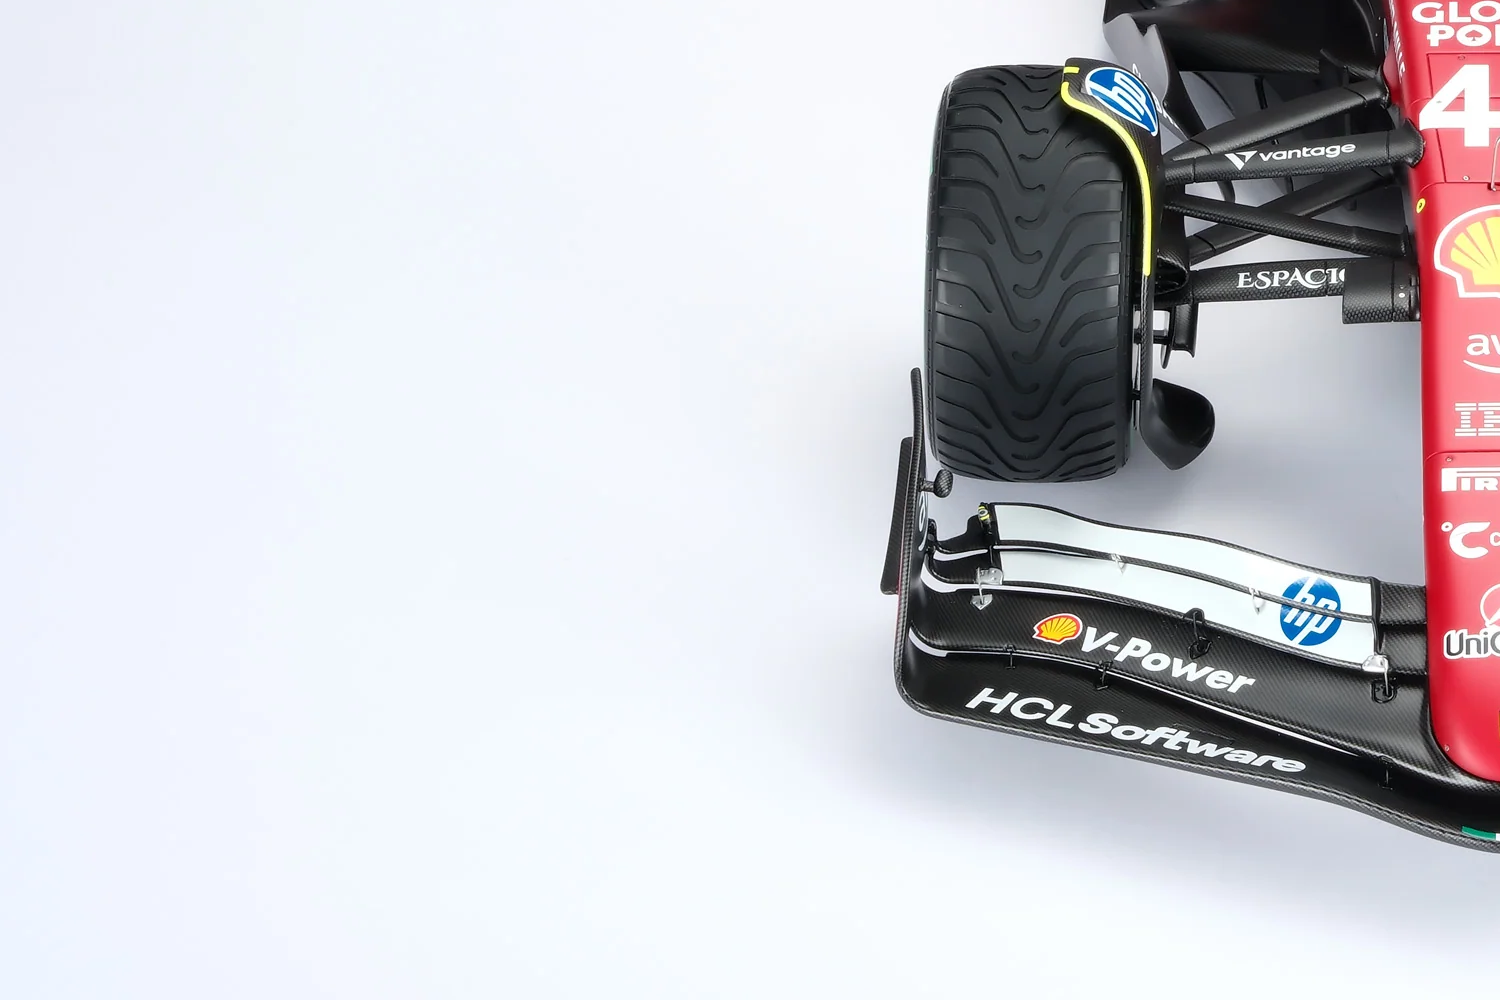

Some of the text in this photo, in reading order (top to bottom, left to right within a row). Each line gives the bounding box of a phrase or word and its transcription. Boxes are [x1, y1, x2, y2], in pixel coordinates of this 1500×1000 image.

[1259, 142, 1356, 162] vantage
[1281, 577, 1337, 646] hp
[1081, 626, 1257, 694] V-Power
